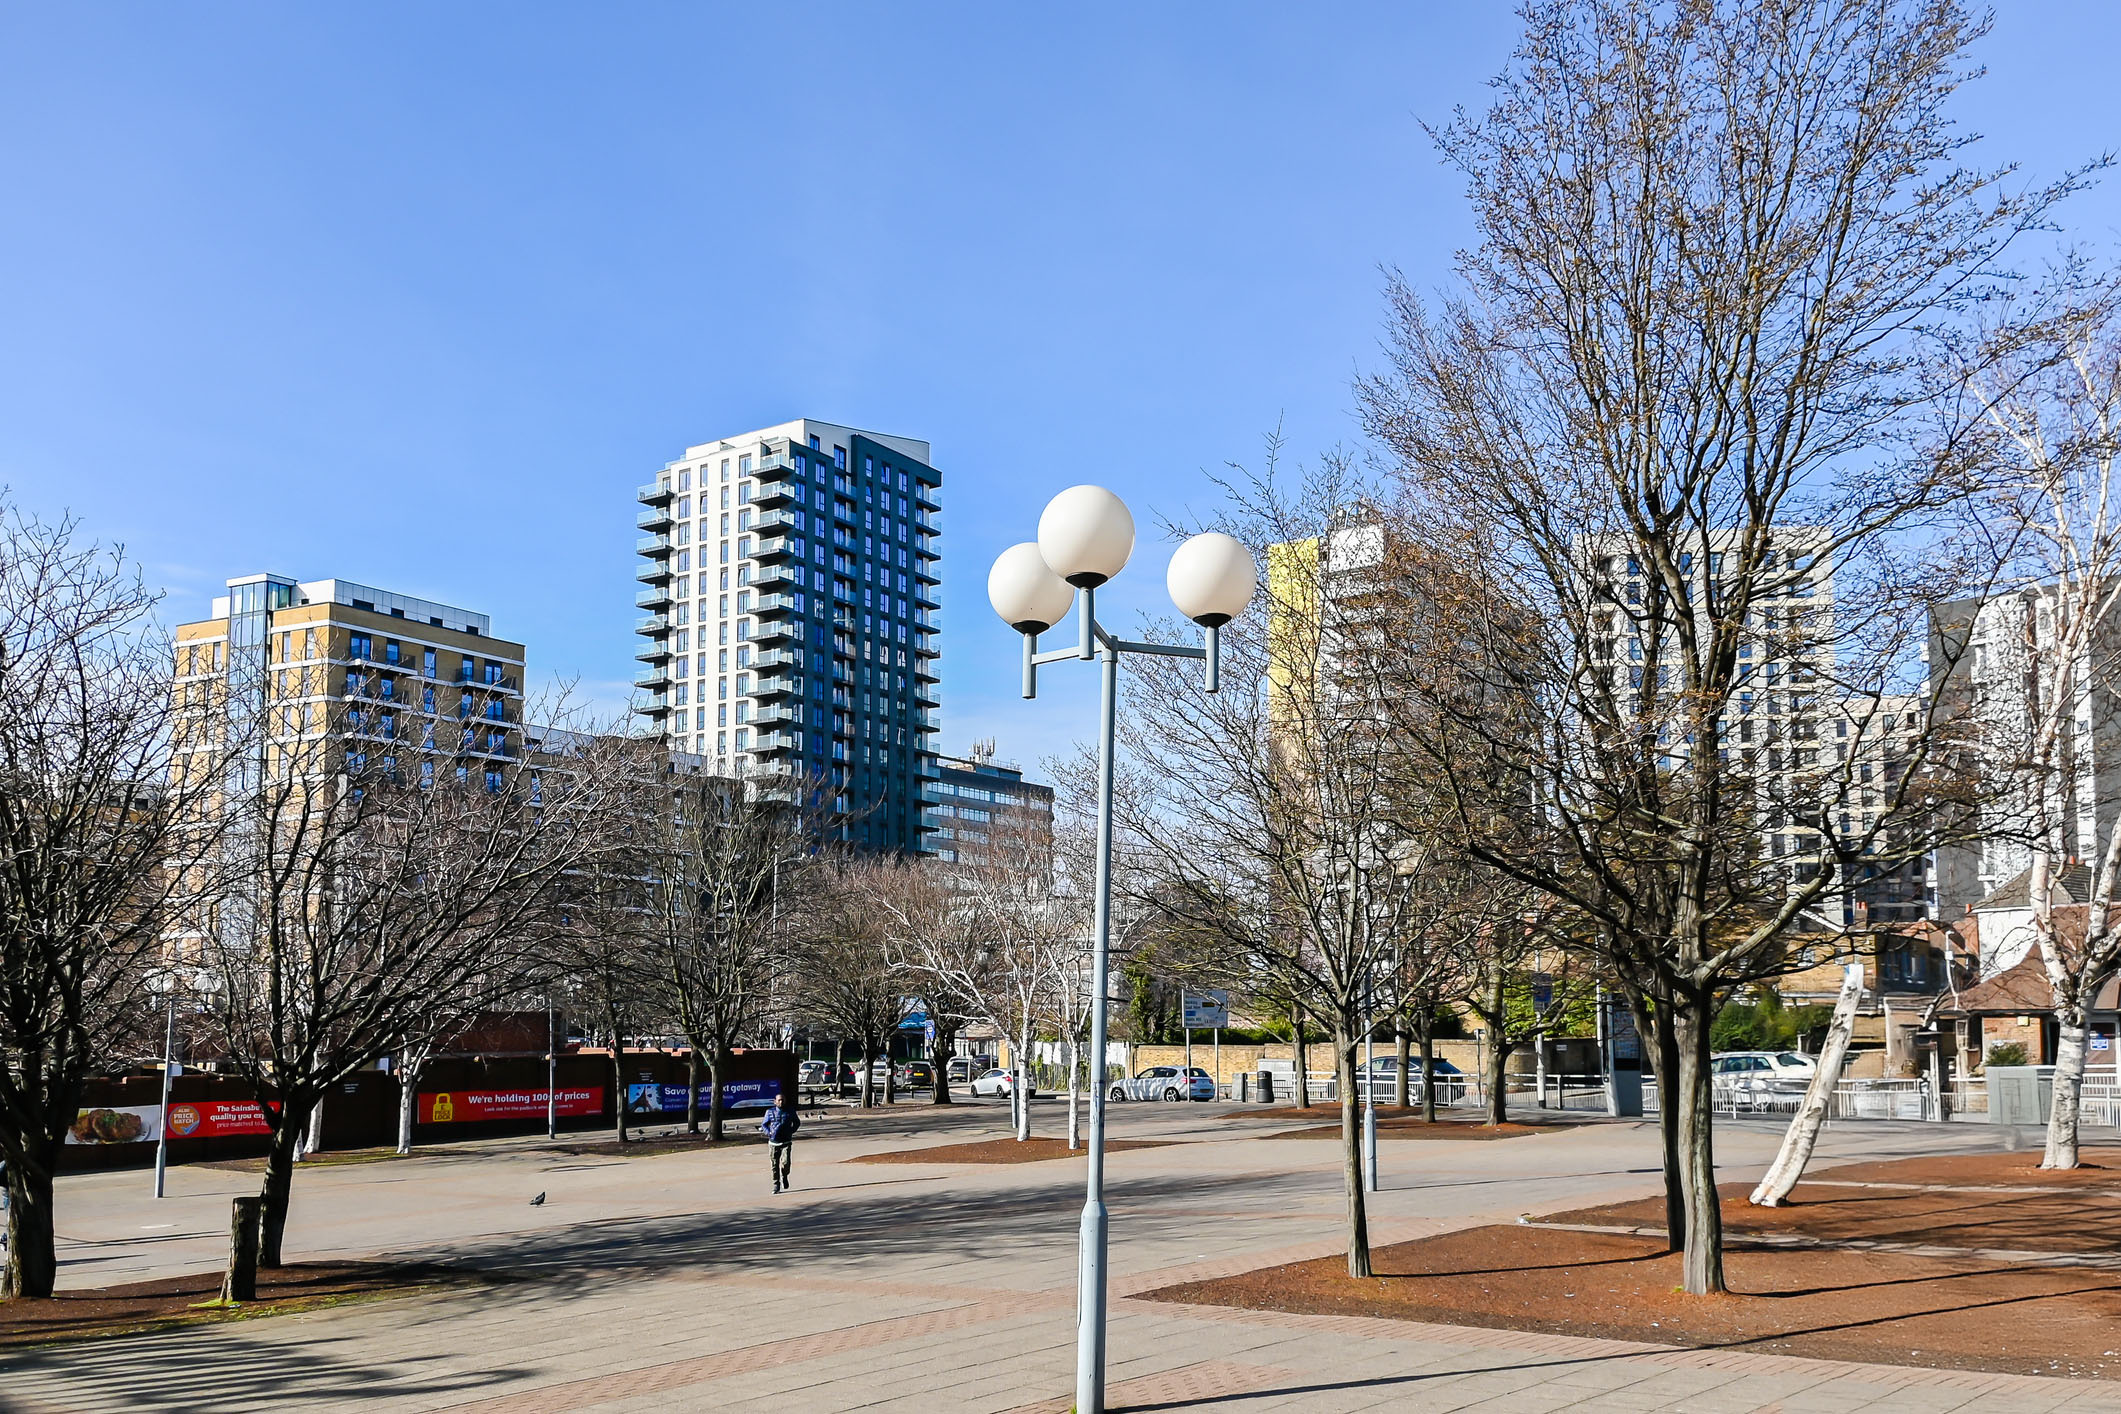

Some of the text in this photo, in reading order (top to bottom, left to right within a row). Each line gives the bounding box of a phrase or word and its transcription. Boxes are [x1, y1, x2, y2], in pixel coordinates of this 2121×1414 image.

[664, 1087, 686, 1095] Save
[731, 1083, 761, 1093] getaway
[468, 1095, 493, 1104] We're
[495, 1094, 530, 1104] holding
[554, 1092, 563, 1100] of
[564, 1091, 590, 1102] prices
[210, 1113, 237, 1121] quality
